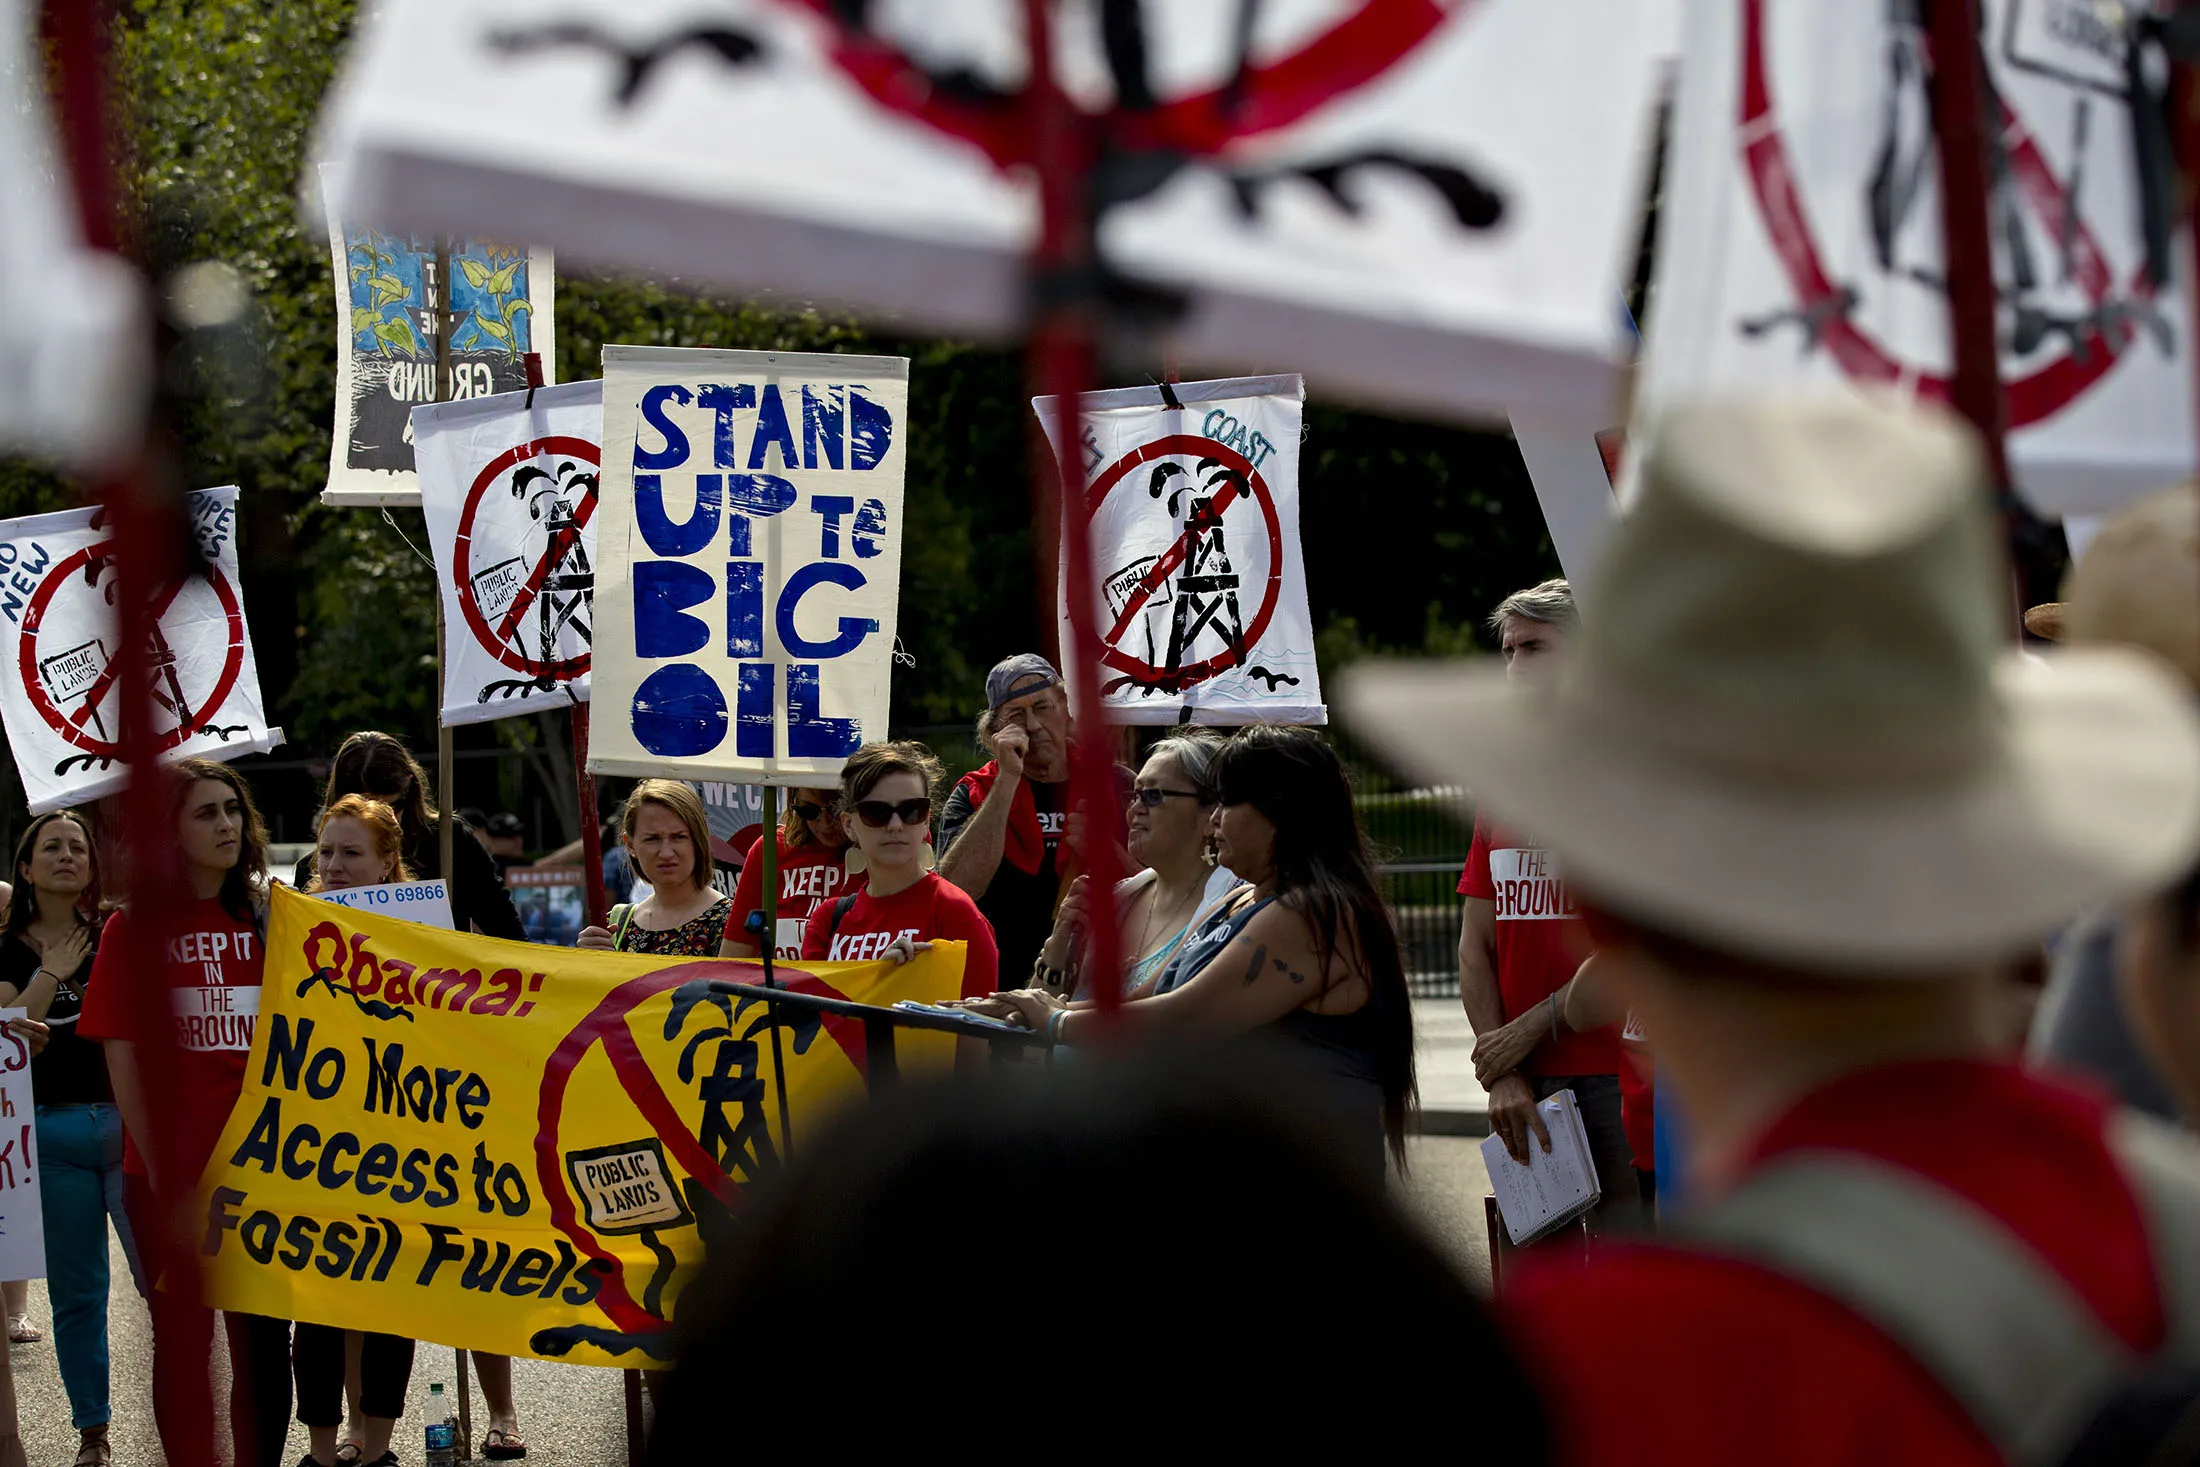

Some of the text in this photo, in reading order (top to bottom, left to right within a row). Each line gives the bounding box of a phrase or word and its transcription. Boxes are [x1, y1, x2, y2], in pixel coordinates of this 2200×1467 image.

[633, 384, 893, 471] STAND
[1201, 408, 1278, 470] COAST
[634, 473, 798, 558] UP
[1, 541, 50, 623] NEW
[480, 566, 517, 596] PUBLIC
[633, 561, 880, 659] BIG
[52, 649, 94, 676] PUBLIC
[61, 663, 99, 691] LANDS
[630, 662, 862, 758] OIL
[702, 782, 739, 809] WE
[1516, 850, 1550, 877] THE
[364, 889, 389, 905] TO
[395, 884, 445, 903] 69866
[782, 865, 840, 899] KEEP
[164, 931, 253, 963] KEEP IT
[828, 931, 891, 961] KEEP
[204, 961, 225, 985] IN
[303, 920, 547, 1017] Obama:
[198, 988, 235, 1013] THE
[174, 1014, 260, 1048] GROUN
[262, 1013, 491, 1130] No More
[229, 1096, 531, 1217] Access to
[585, 1153, 650, 1190] PUBLIC
[599, 1180, 661, 1214] LANDS
[201, 1185, 613, 1305] Fossil Fuels
